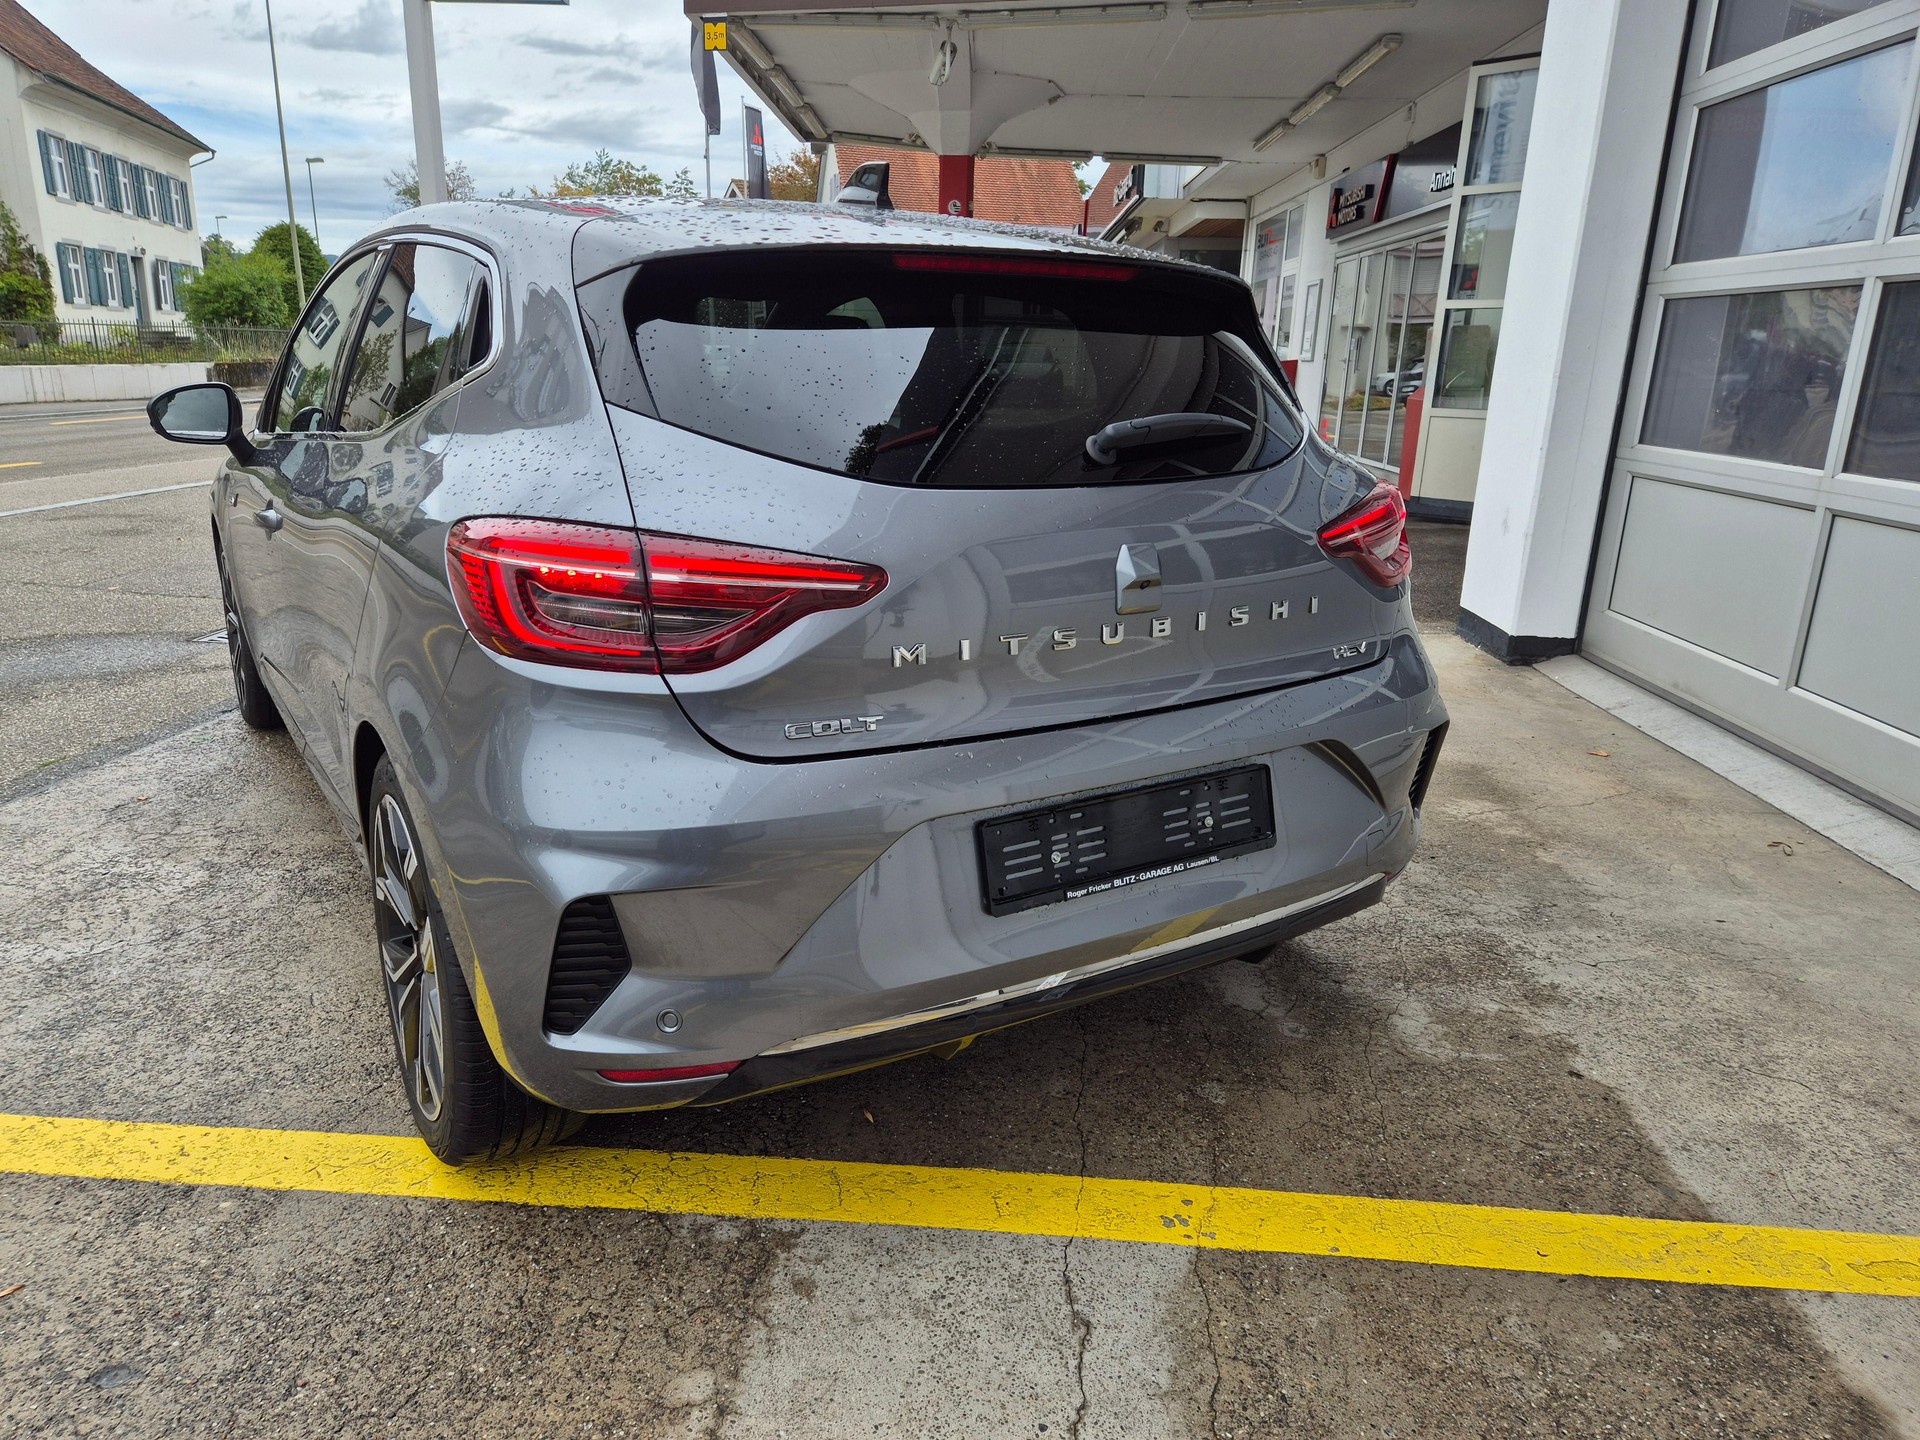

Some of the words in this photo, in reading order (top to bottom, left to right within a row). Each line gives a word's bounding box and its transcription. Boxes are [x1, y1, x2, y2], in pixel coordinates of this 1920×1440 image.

[1339, 184, 1366, 208] MITSUBISHI
[1337, 204, 1357, 225] MOTORS
[891, 594, 1319, 667] MITSUBISHI
[784, 715, 884, 740] COLT
[1067, 888, 1088, 899] Roger
[1089, 882, 1112, 894] Fricker
[1113, 865, 1173, 887] BLITZ-GARAGE
[1173, 863, 1185, 873] AG
[1186, 855, 1220, 869] Lausen/BL
